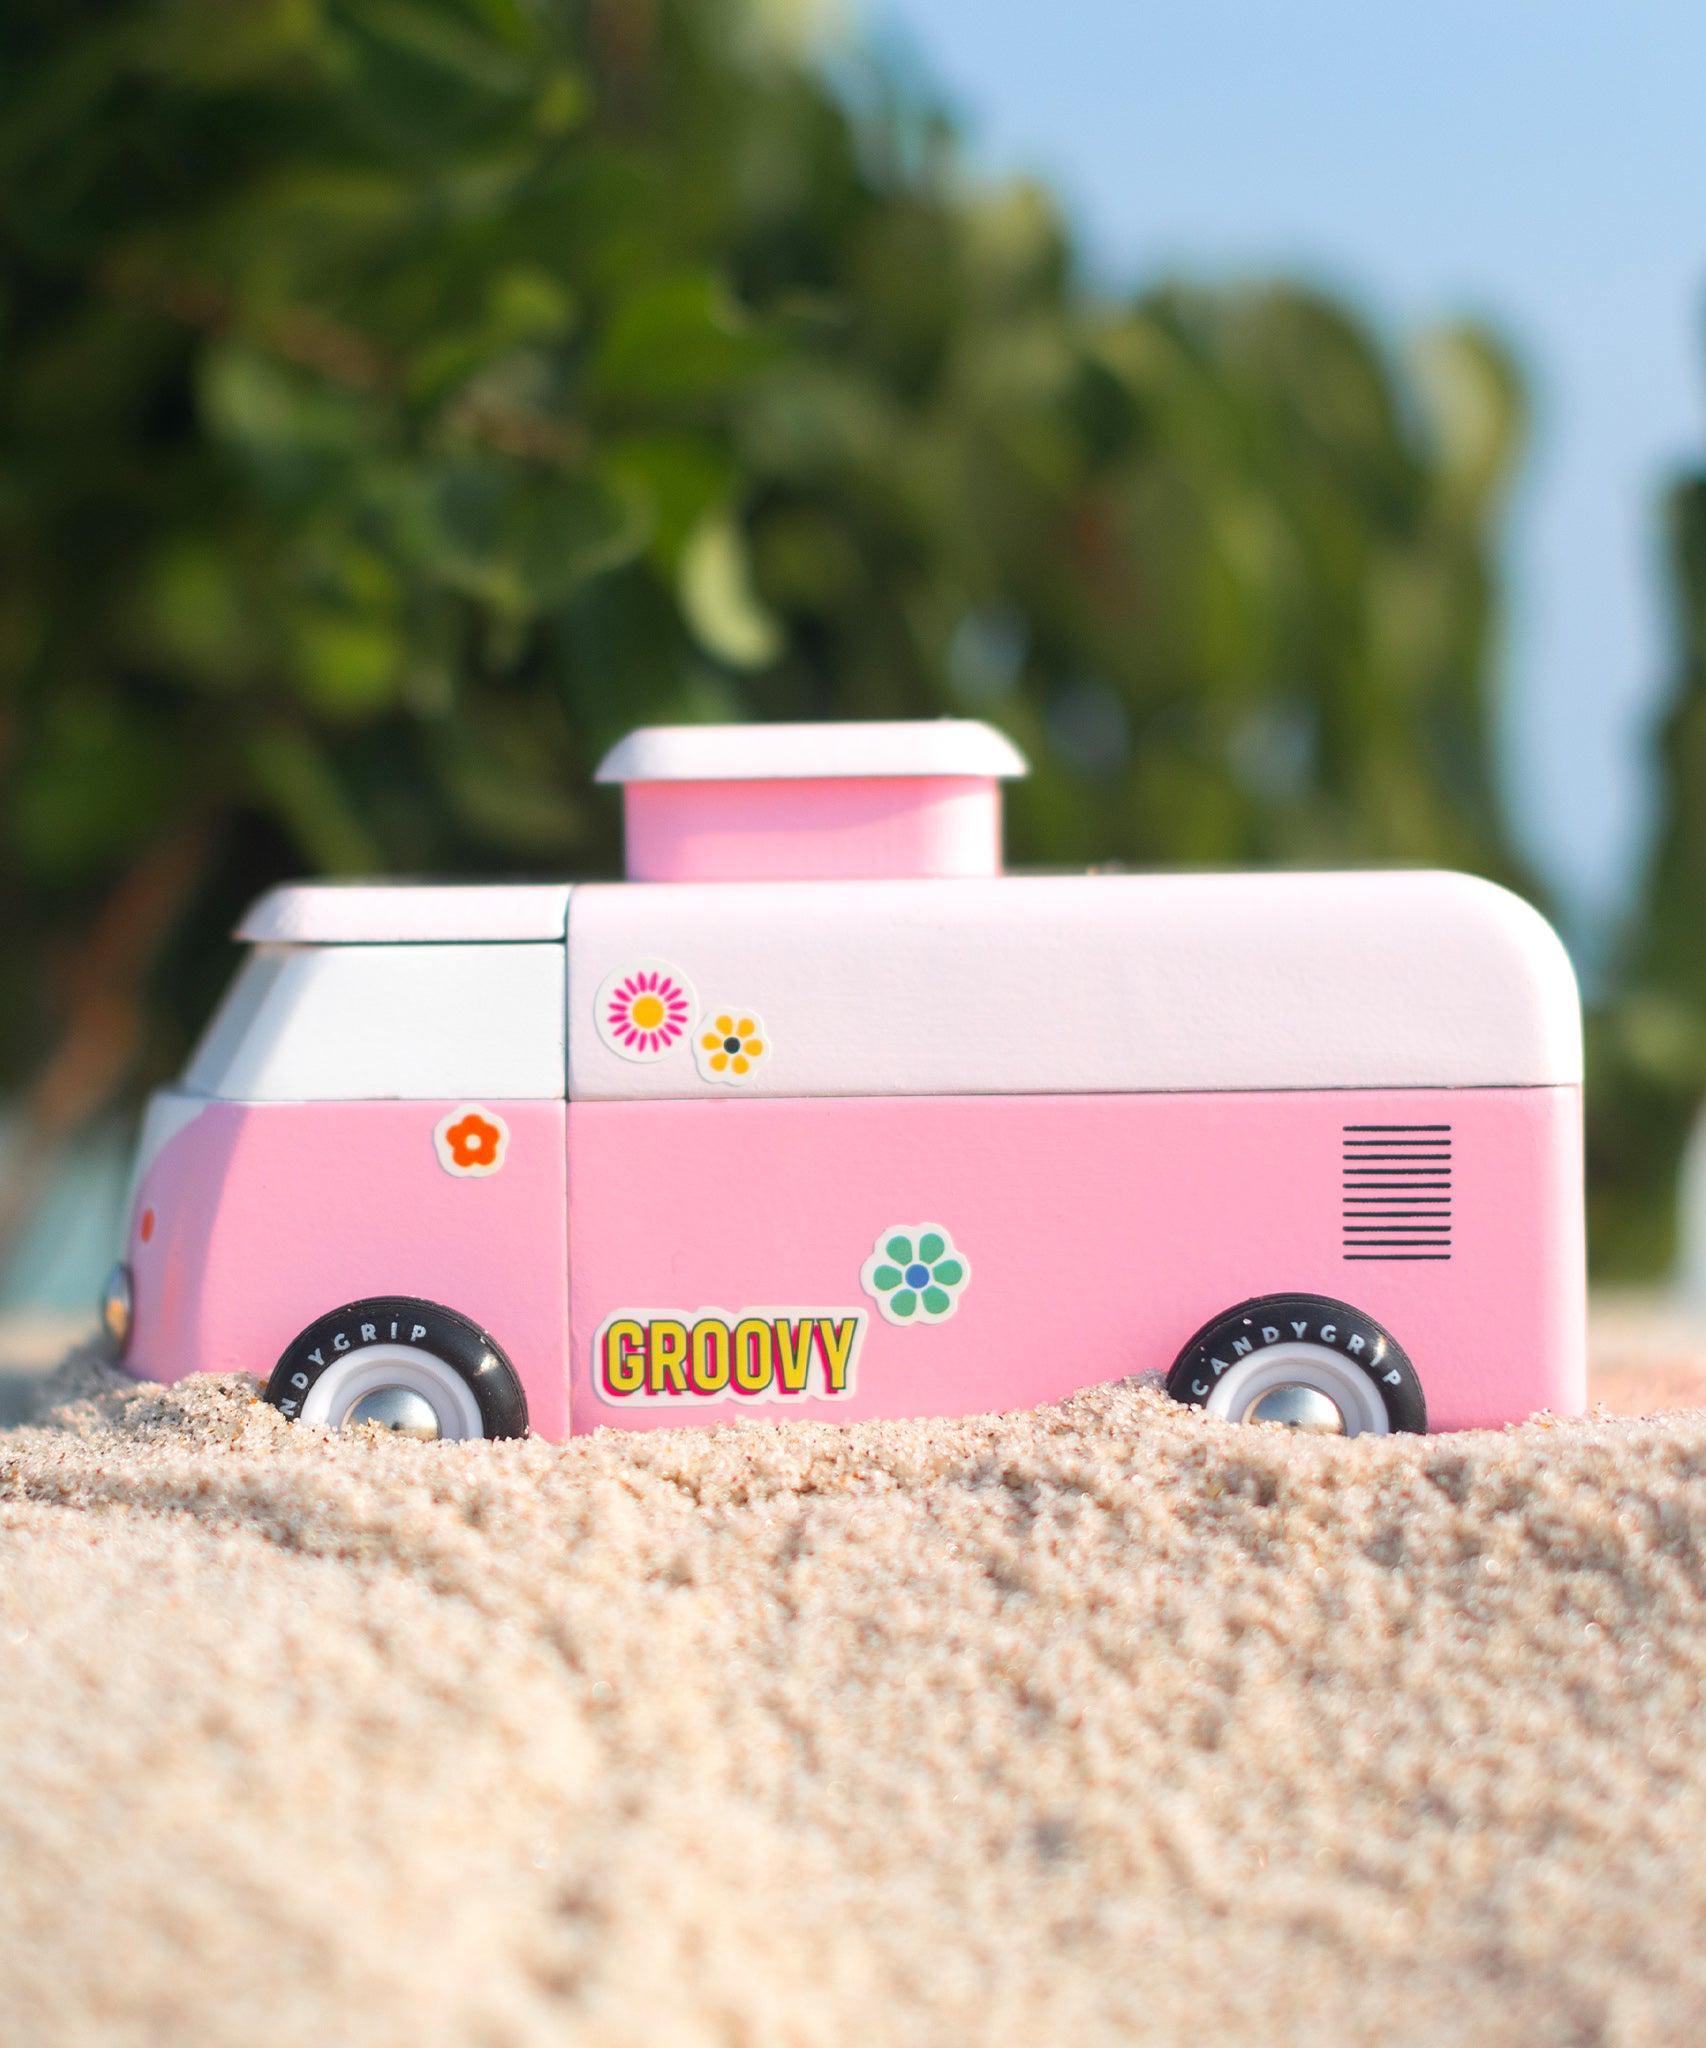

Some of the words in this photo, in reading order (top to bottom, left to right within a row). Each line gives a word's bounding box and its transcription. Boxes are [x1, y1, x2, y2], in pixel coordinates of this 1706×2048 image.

[279, 1321, 427, 1416] NDYGRIP
[602, 1317, 859, 1396] GROOVY
[1191, 1321, 1401, 1396] CANDYGRIP
